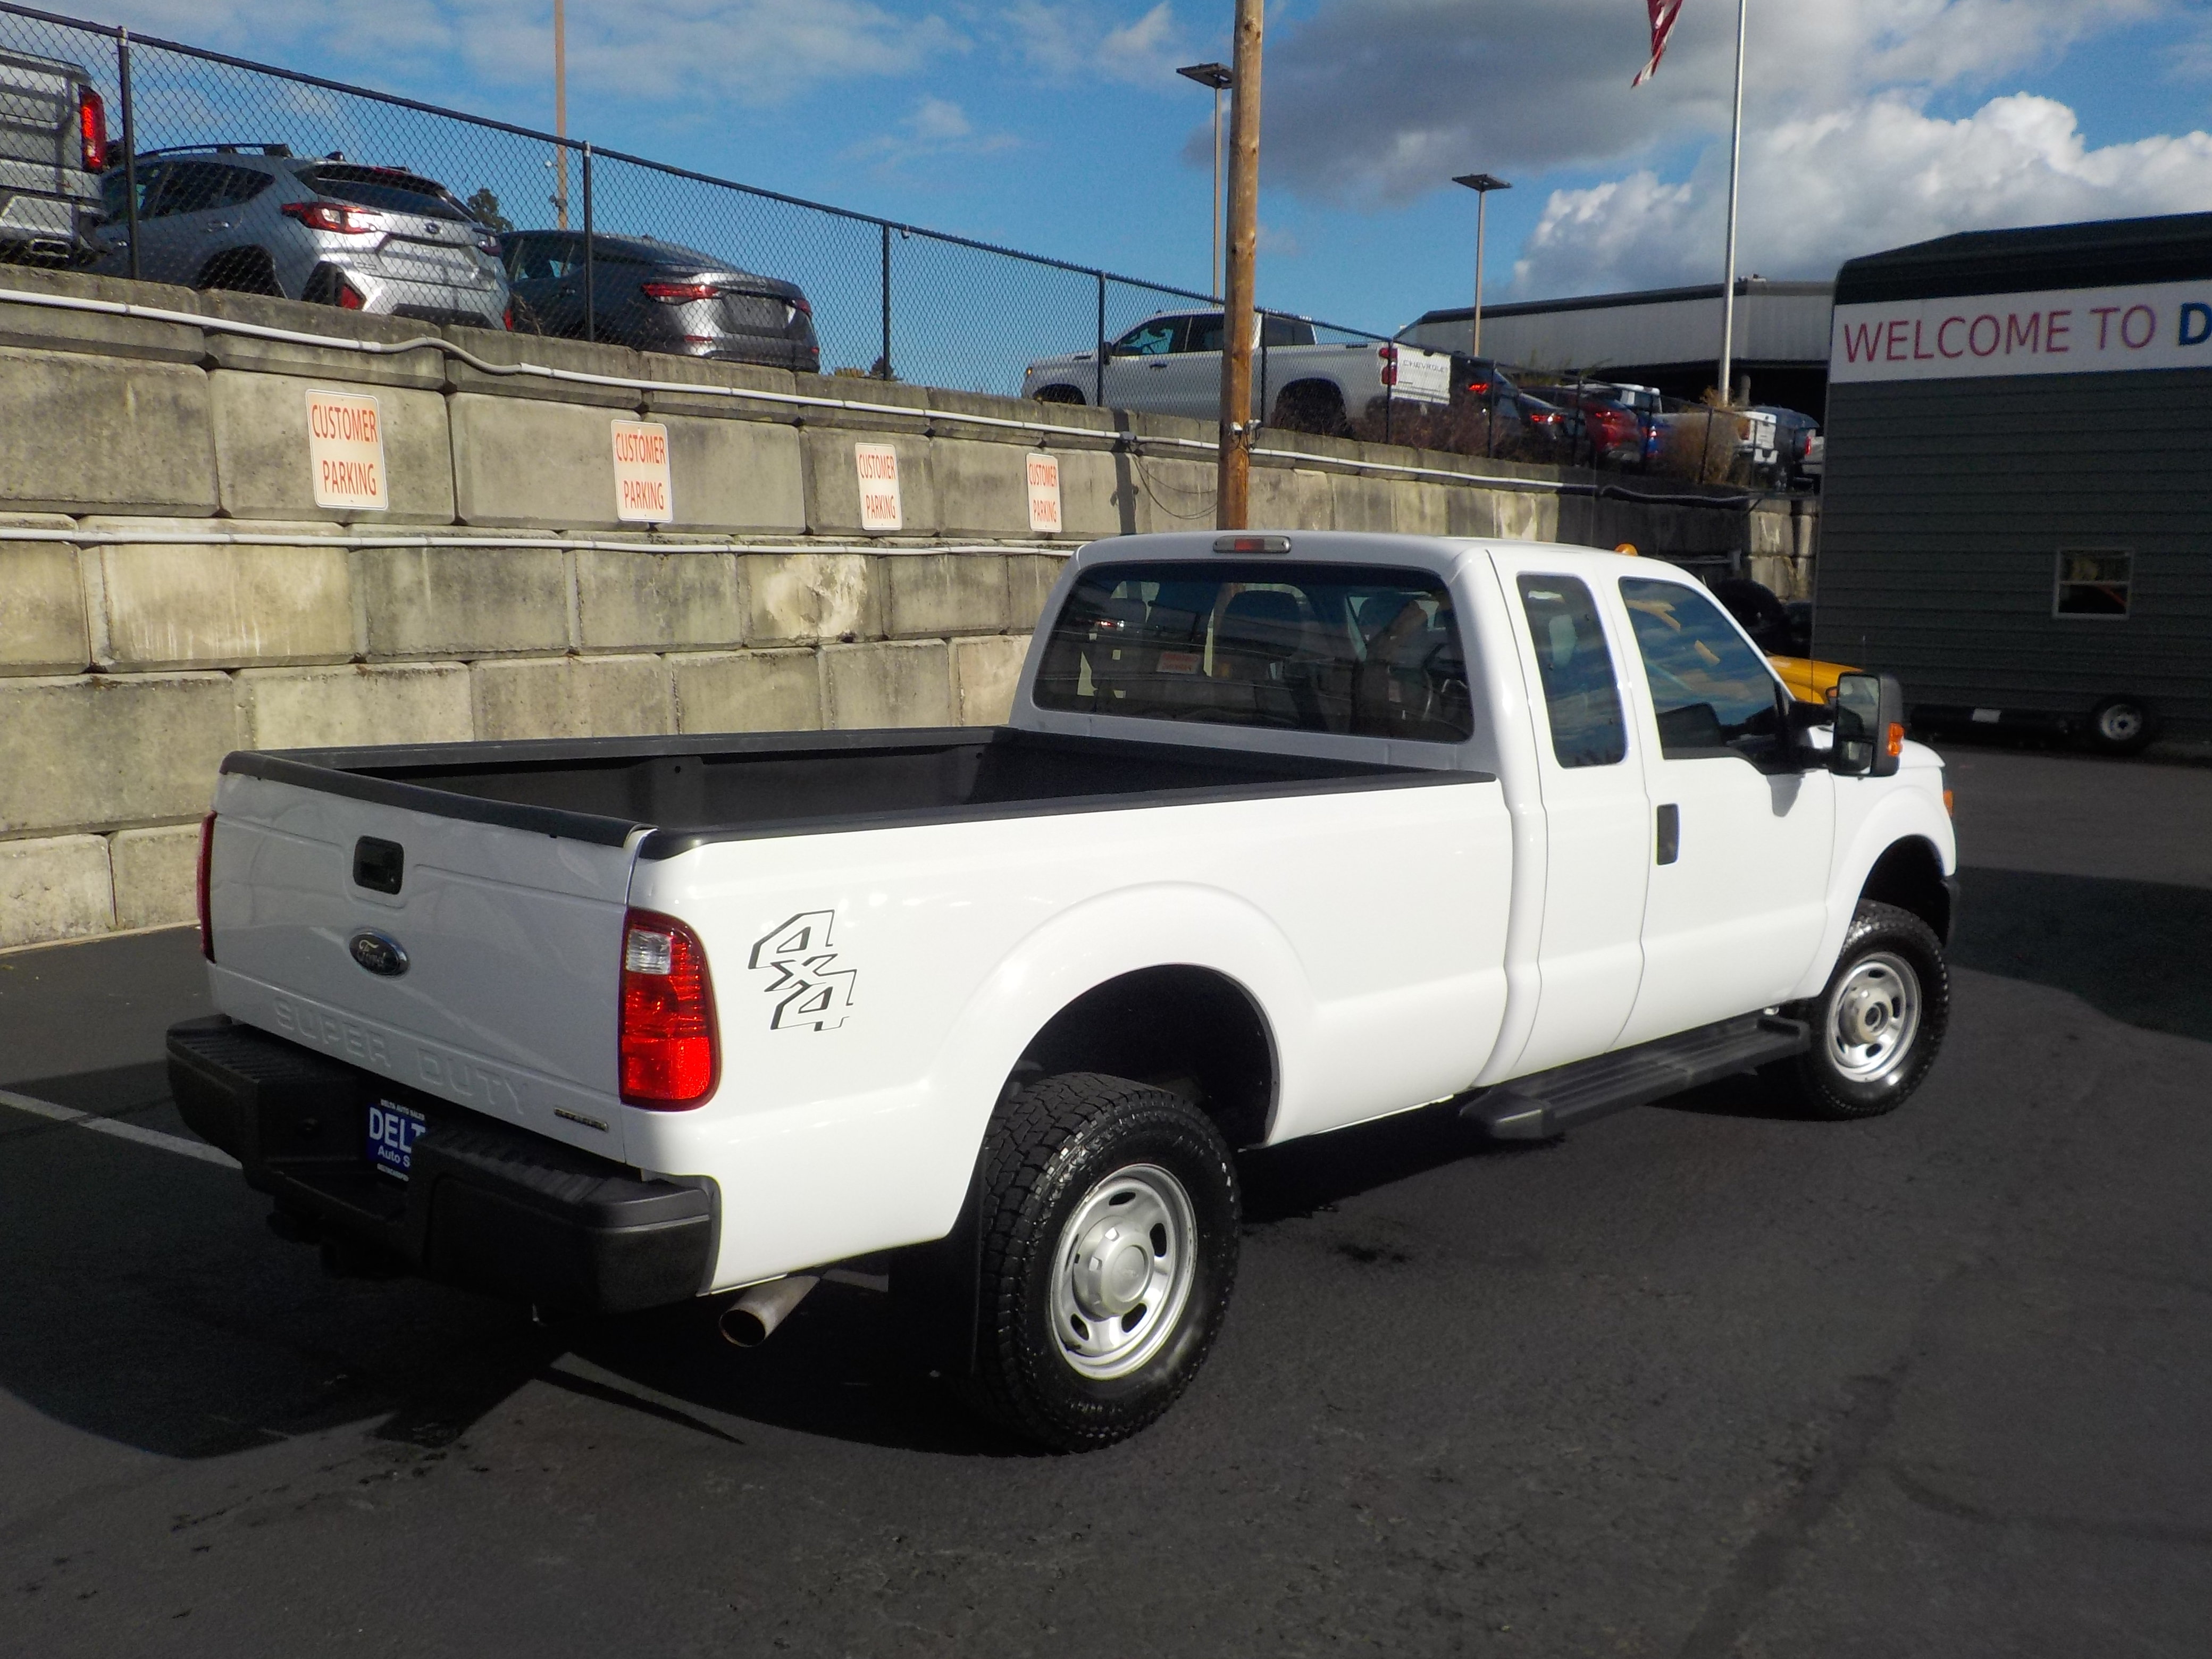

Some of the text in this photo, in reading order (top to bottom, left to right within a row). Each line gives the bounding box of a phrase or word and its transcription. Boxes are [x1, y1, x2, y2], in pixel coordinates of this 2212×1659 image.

[1844, 309, 2072, 363] WELCOME
[2090, 304, 2157, 350] TO
[311, 404, 378, 442] CUSTOMER
[615, 432, 666, 465] CUSTOMER
[323, 459, 376, 496] PARKING
[859, 454, 895, 480] CUSTOMER
[1028, 463, 1058, 488] CUSTOMER
[624, 480, 664, 510] PARKING
[866, 495, 895, 520] PARKING
[1033, 499, 1057, 523] PARKING
[274, 996, 528, 1115] SUPER DUTY
[378, 1145, 401, 1164] Auto
